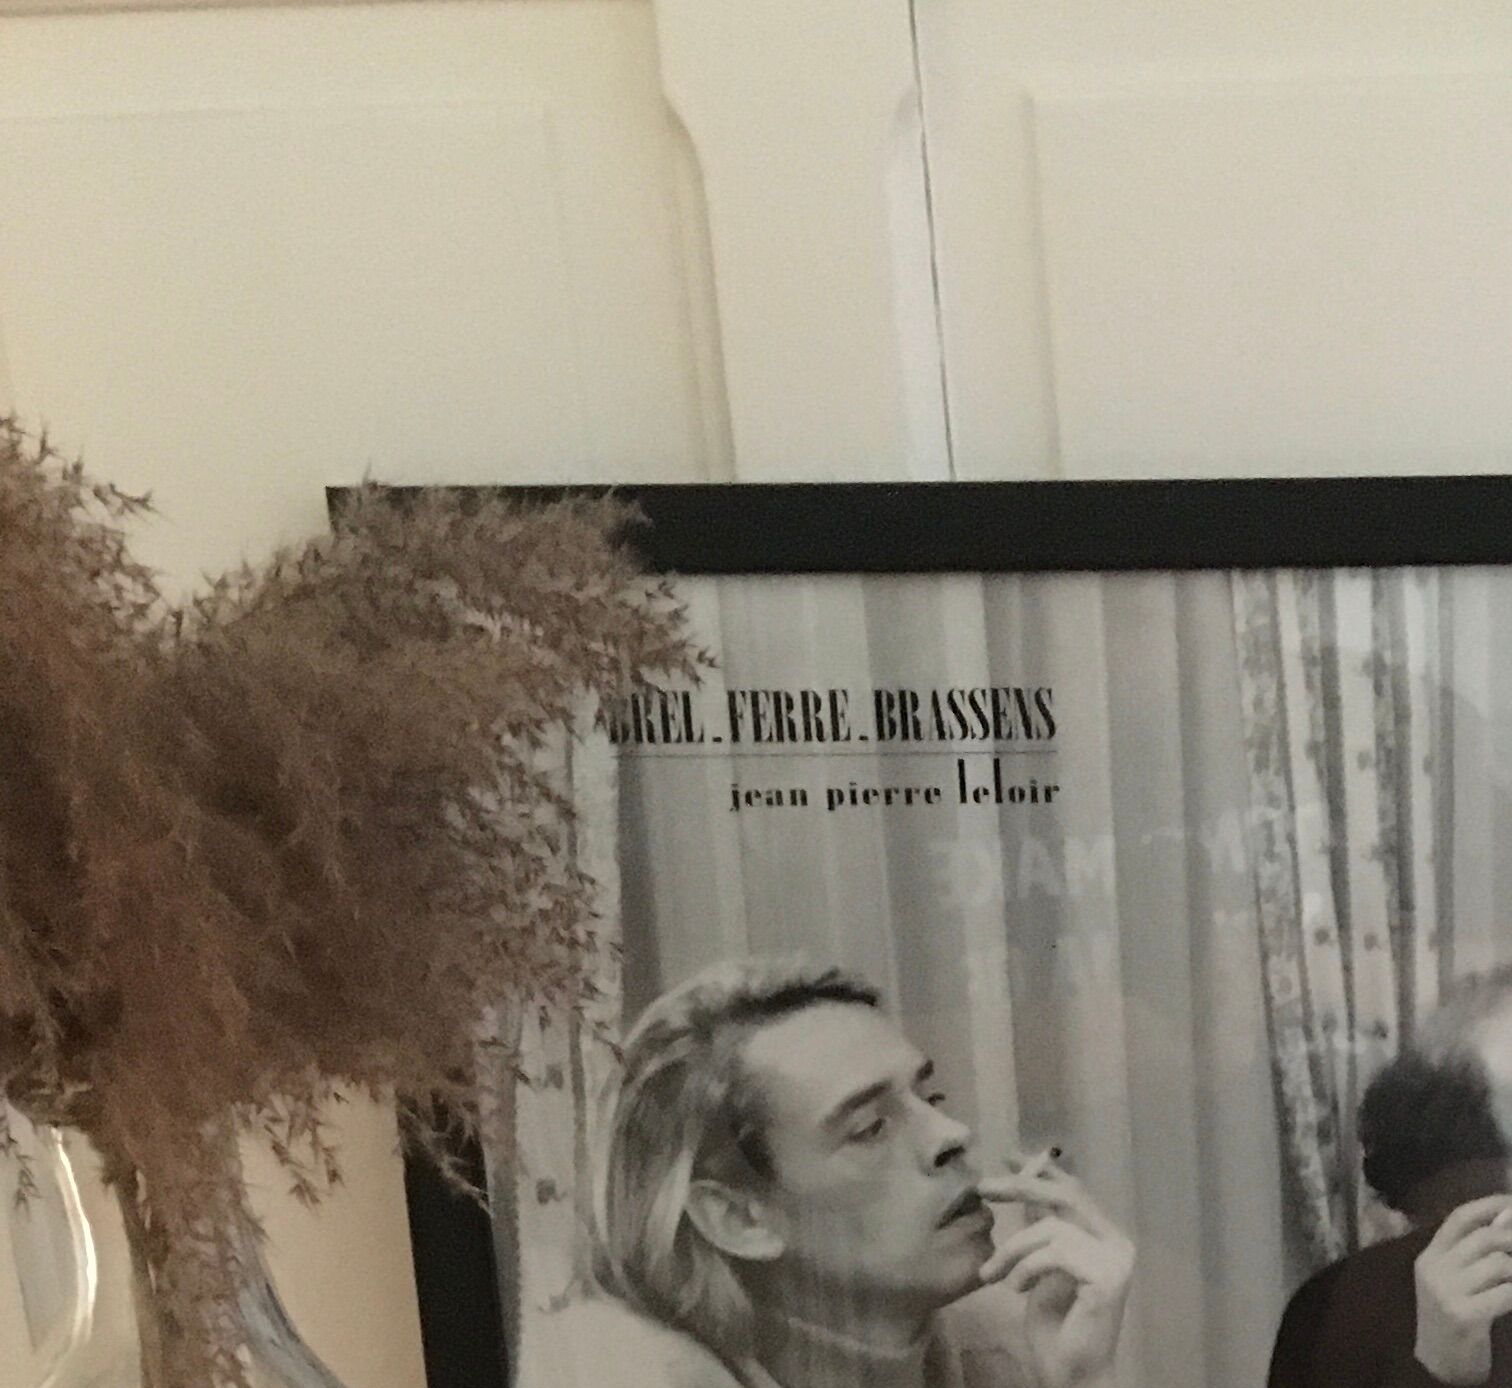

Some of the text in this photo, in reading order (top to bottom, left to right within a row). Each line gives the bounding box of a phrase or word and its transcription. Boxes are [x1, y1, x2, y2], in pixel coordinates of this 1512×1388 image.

[729, 757, 1060, 812] jean pierre leloir
